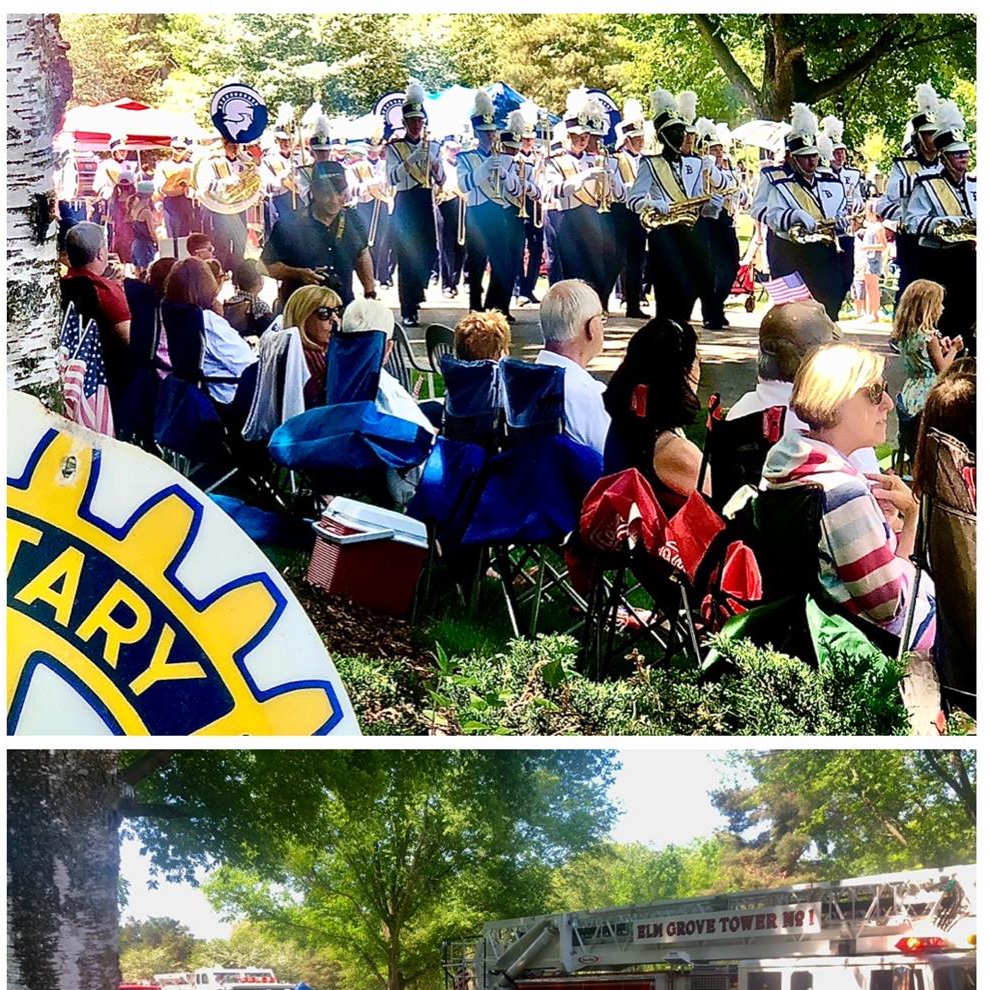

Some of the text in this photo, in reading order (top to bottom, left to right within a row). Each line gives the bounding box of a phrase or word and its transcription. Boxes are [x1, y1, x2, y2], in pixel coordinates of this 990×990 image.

[637, 922, 663, 939] ELM
[666, 918, 716, 937] GROVE
[719, 912, 778, 932] TOWER
